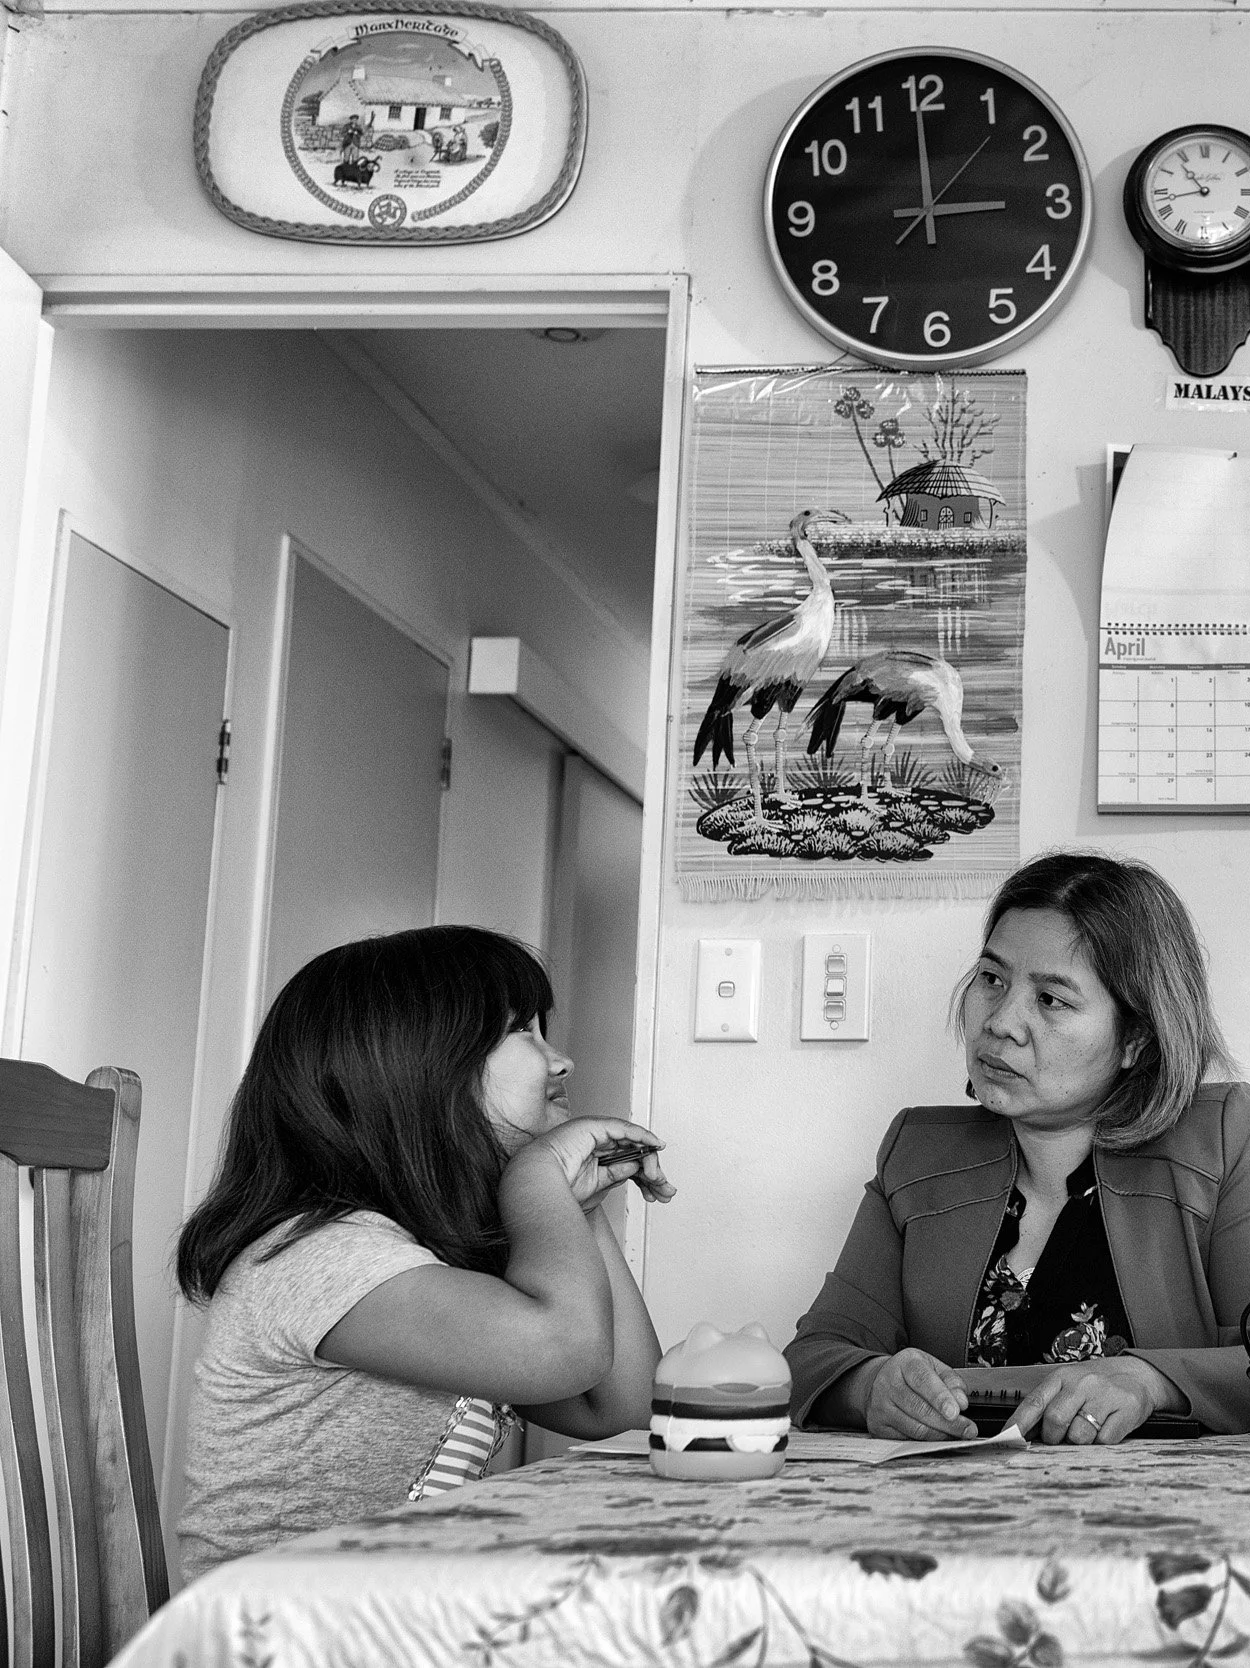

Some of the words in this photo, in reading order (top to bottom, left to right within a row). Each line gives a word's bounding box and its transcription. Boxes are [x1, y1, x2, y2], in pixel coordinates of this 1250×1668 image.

[901, 74, 946, 112] 12
[980, 88, 995, 124] 1
[846, 96, 883, 133] 11
[805, 140, 847, 176] 10
[1023, 125, 1049, 161] 2
[788, 201, 815, 237] 9
[1046, 184, 1072, 219] 3
[812, 260, 839, 295] 8
[1026, 244, 1056, 280] 4
[863, 296, 888, 333] 7
[989, 288, 1016, 324] 5
[924, 311, 951, 347] 6
[1104, 637, 1146, 661] April
